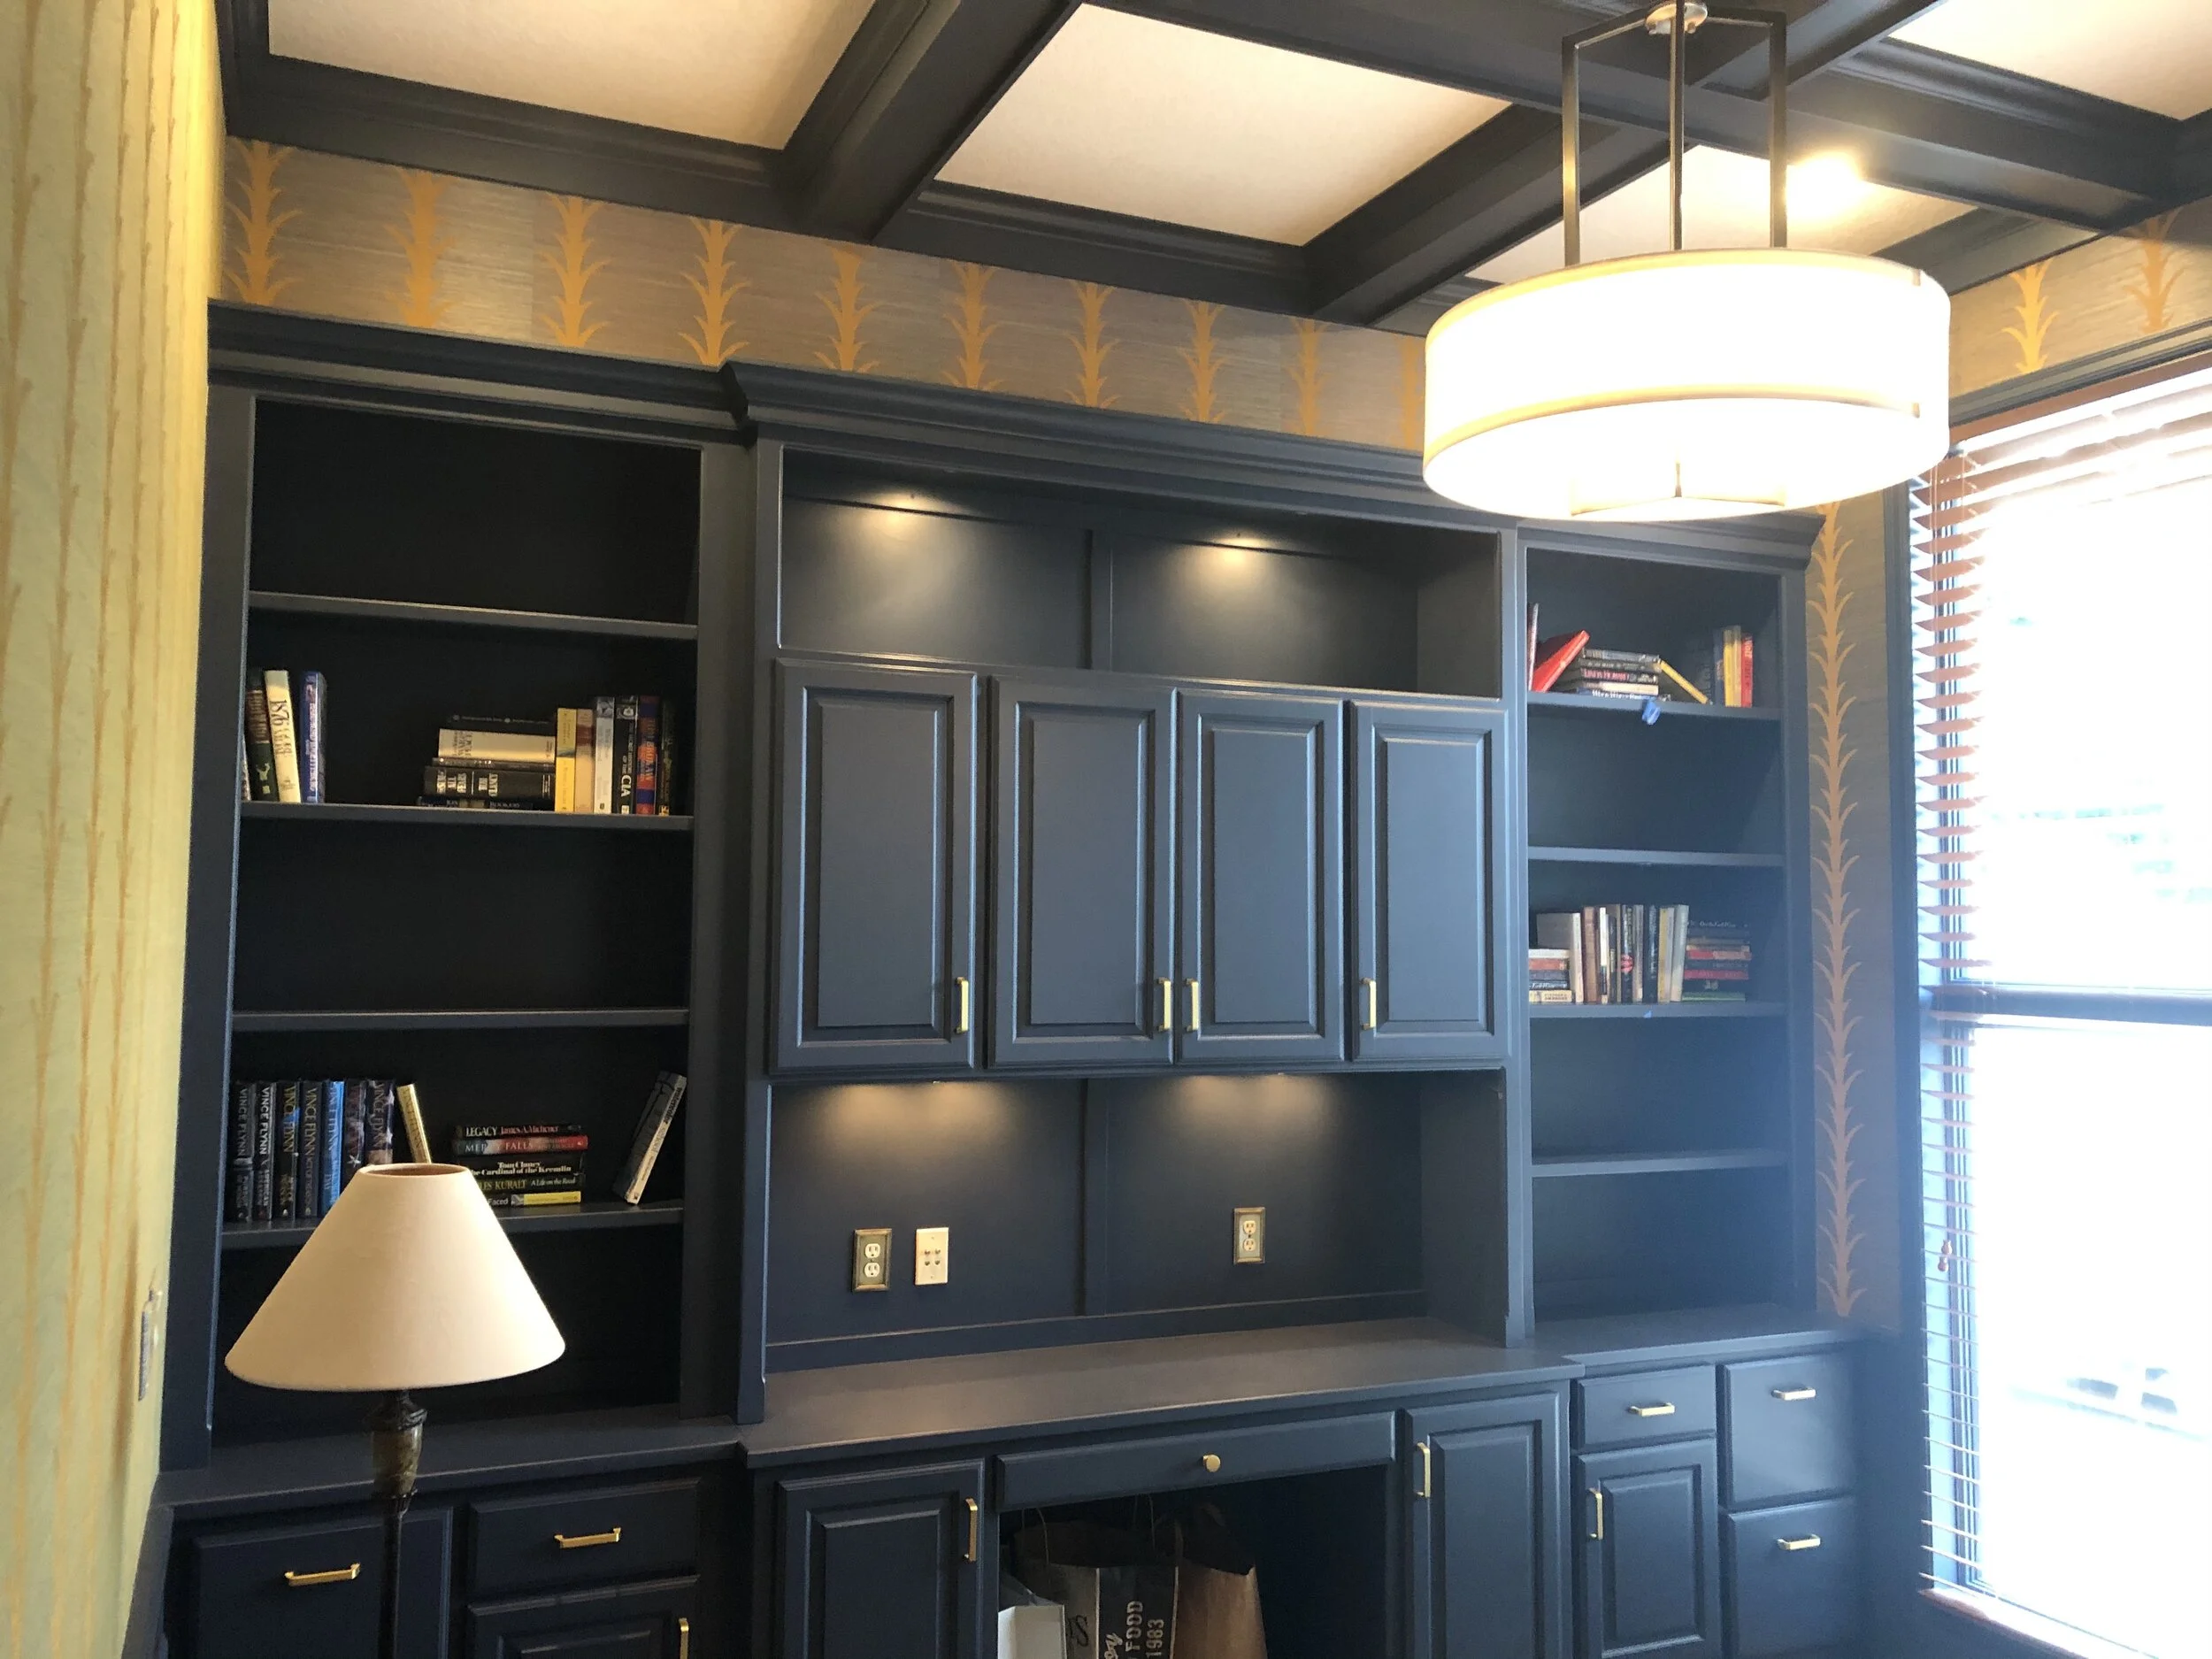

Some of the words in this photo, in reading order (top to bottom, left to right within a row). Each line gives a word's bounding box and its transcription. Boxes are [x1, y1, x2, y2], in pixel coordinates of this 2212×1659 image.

[269, 699, 290, 726] 1876
[620, 774, 632, 797] CIA
[237, 1088, 249, 1121] VINCE
[259, 1087, 270, 1119] VINCE
[283, 1085, 296, 1116] VINCE
[305, 1087, 318, 1122] VINCE
[373, 1083, 385, 1113] VINCE
[236, 1124, 247, 1156] FLYNN
[258, 1122, 269, 1155] FLYNN
[283, 1121, 296, 1153] FLYNN
[304, 1123, 317, 1156] FLYNN
[372, 1117, 384, 1148] FLYNN
[465, 1125, 497, 1137] LEGACY
[495, 1179, 527, 1190] KURALT
[1125, 1601, 1143, 1651] FOOD
[1145, 1618, 1164, 1657] 1983
